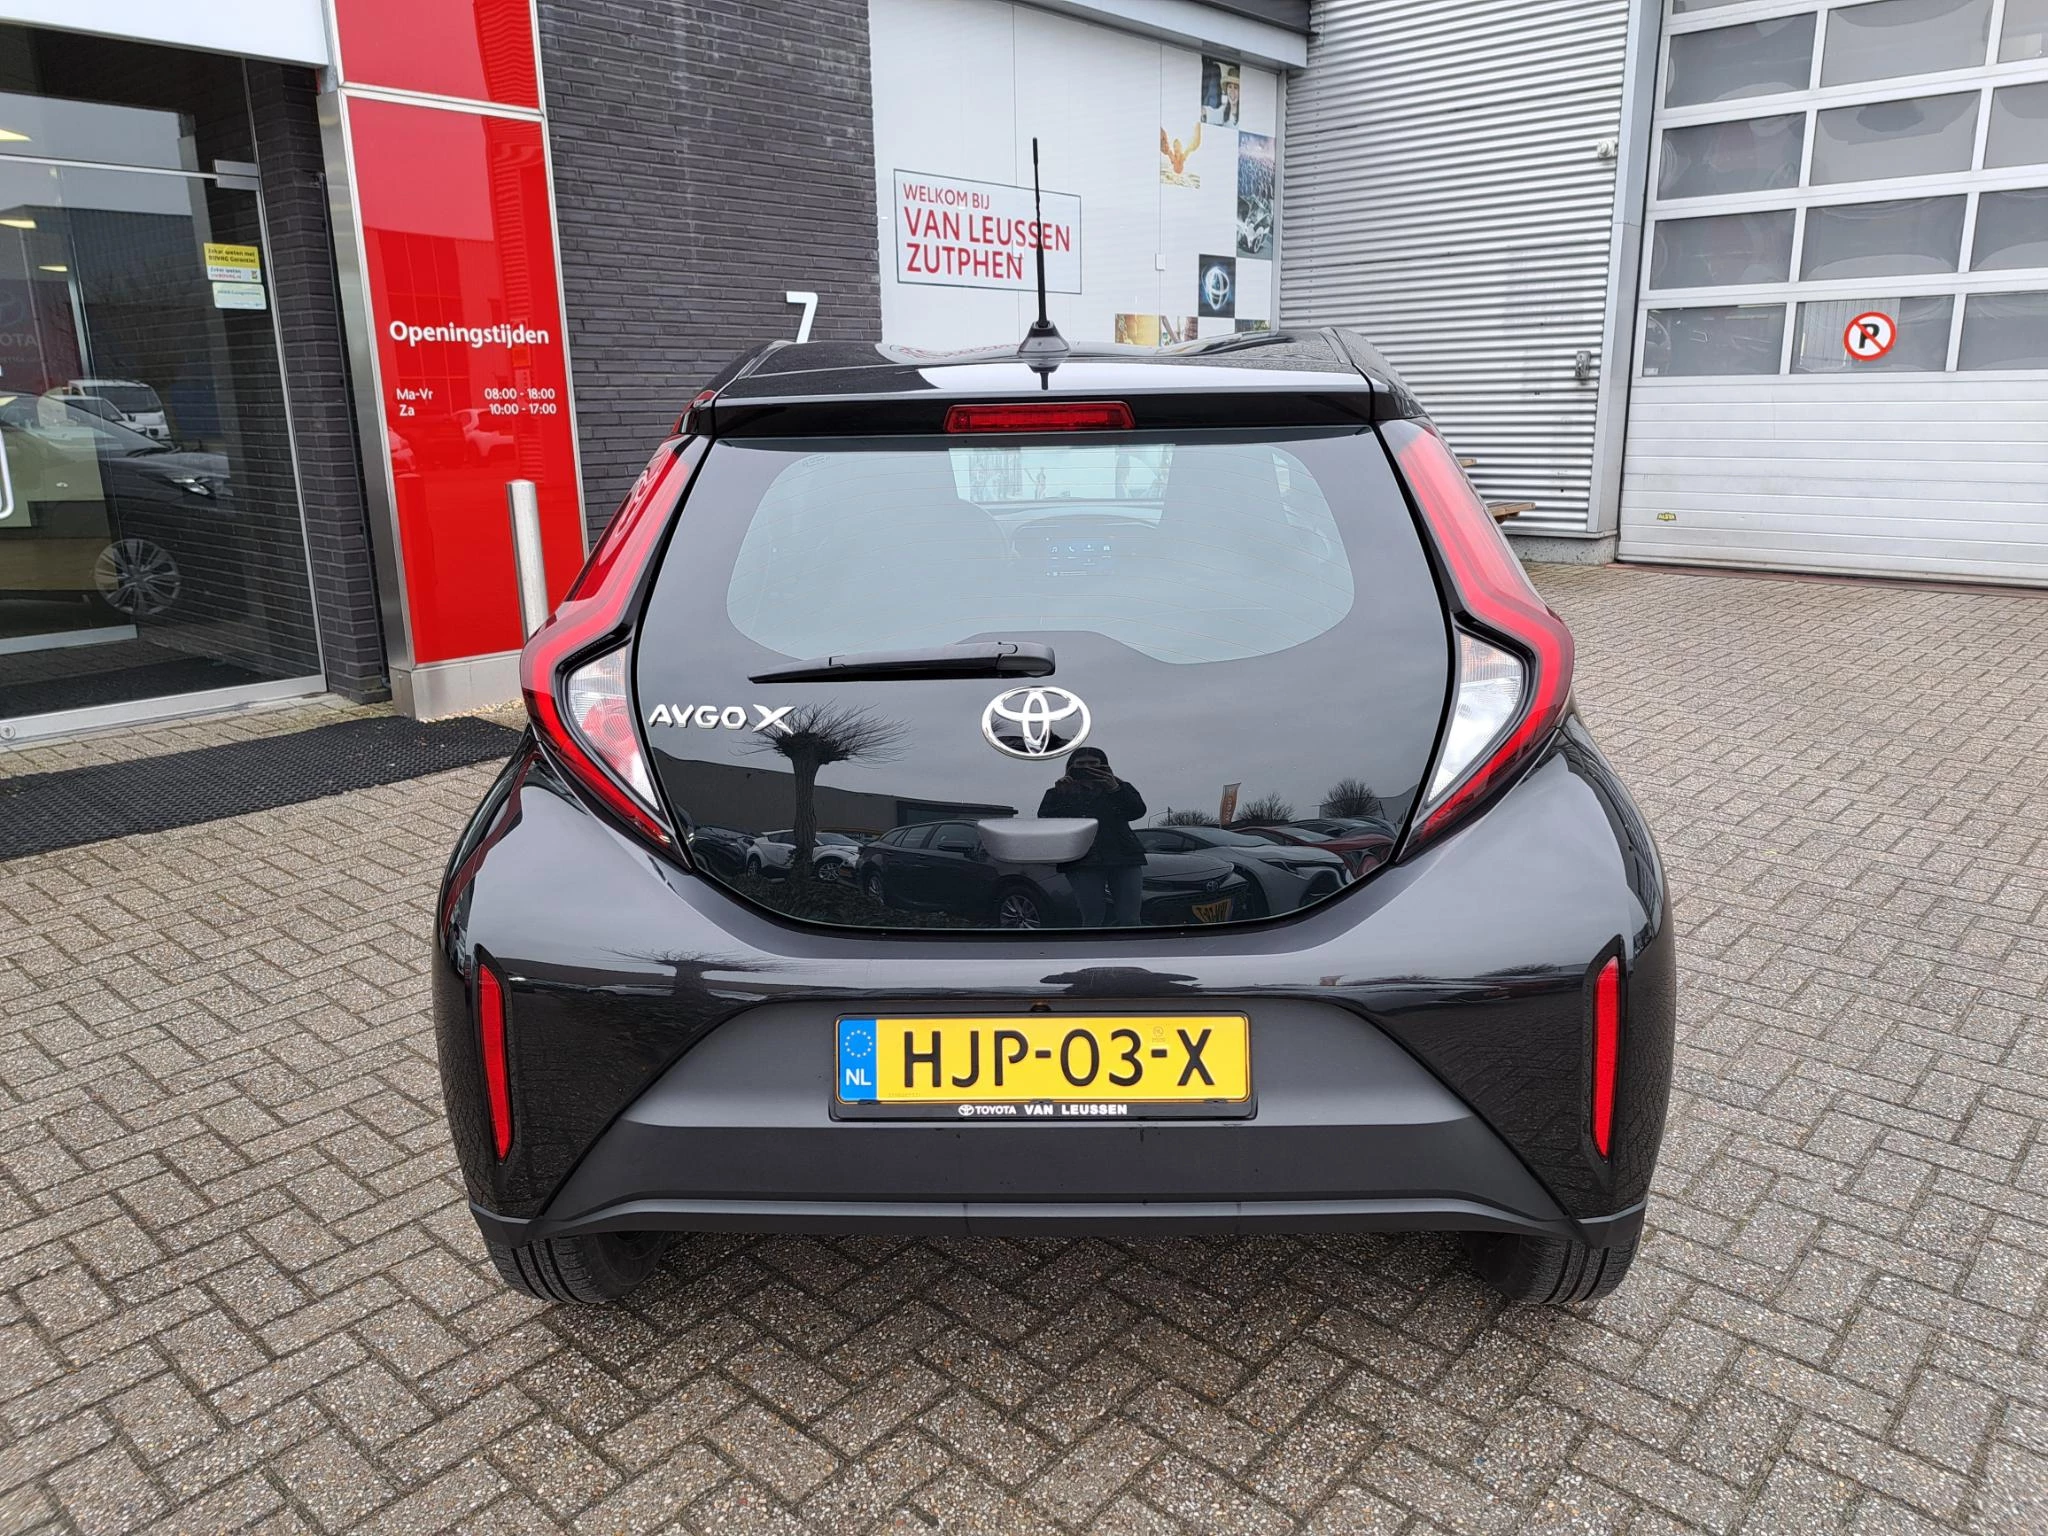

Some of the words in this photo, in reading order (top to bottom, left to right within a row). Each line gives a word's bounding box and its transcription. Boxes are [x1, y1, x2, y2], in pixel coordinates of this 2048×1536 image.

[902, 183, 968, 207] WELKOM
[972, 192, 990, 210] BIJ
[904, 206, 961, 241] VAN
[968, 213, 1071, 252] LEUSSEN
[906, 243, 1023, 280] ZUTPHEN
[786, 291, 818, 344] 7
[389, 320, 550, 349] Openingstijden
[396, 387, 433, 401] Ma-Vr
[484, 388, 517, 400] 08:00
[526, 388, 556, 400] 18:00
[399, 404, 415, 417] Za
[489, 403, 519, 415] 10:00
[528, 403, 557, 415] 17:00
[648, 703, 748, 730] AYGO
[751, 703, 796, 736] X
[903, 1028, 1215, 1089] HJP-03-X
[845, 1069, 872, 1086] NL
[975, 1104, 1017, 1115] TOYOTA
[1024, 1104, 1054, 1115] VAN
[1061, 1104, 1128, 1115] LEUSSEN
